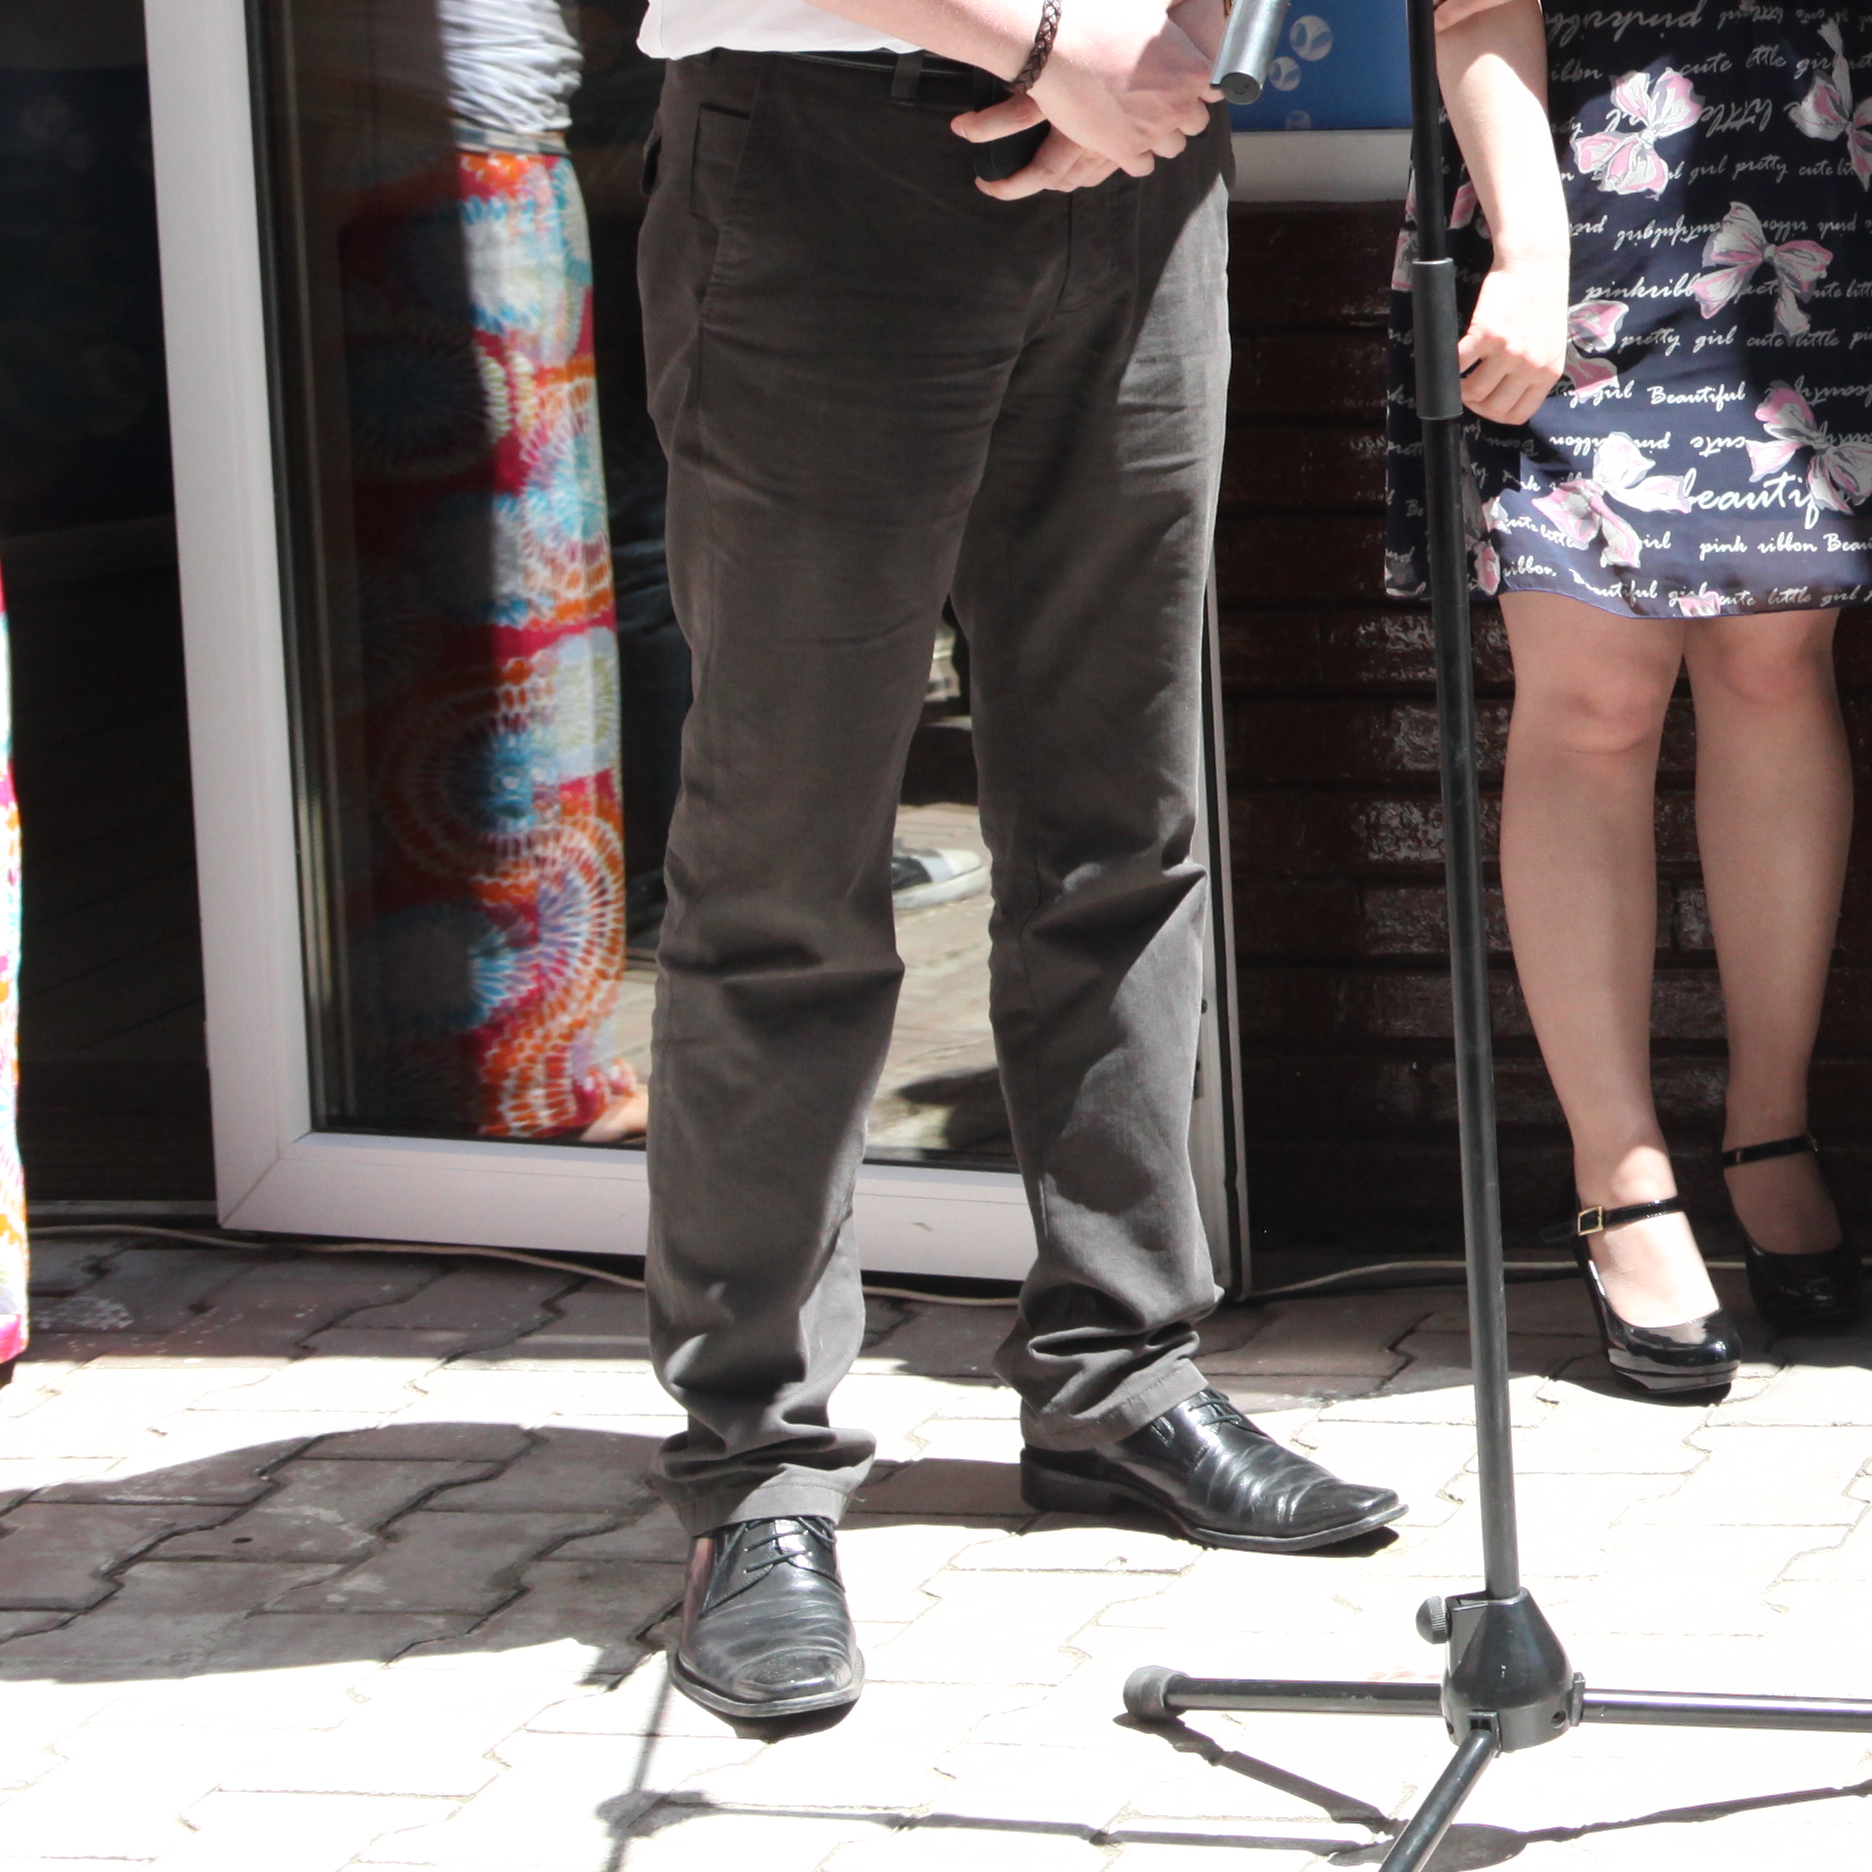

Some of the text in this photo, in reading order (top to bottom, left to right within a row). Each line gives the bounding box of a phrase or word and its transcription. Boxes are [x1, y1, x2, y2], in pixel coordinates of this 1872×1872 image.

[1679, 51, 1733, 76] cute
[1794, 52, 1834, 79] gir
[1690, 155, 1728, 184] girl
[1732, 154, 1788, 183] pretty
[1798, 158, 1834, 176] cute
[1812, 281, 1843, 299] ute
[1618, 327, 1681, 356] pretty
[1693, 325, 1738, 353] girl
[1746, 331, 1785, 346] cute
[1794, 328, 1841, 347] little
[1647, 381, 1746, 411] Beautiful
[1634, 431, 1671, 453] pin
[1690, 434, 1746, 457] cute
[1699, 534, 1749, 560] pink
[1757, 531, 1818, 554] ribbon
[1767, 586, 1813, 606] little
[1820, 583, 1862, 608] girl
